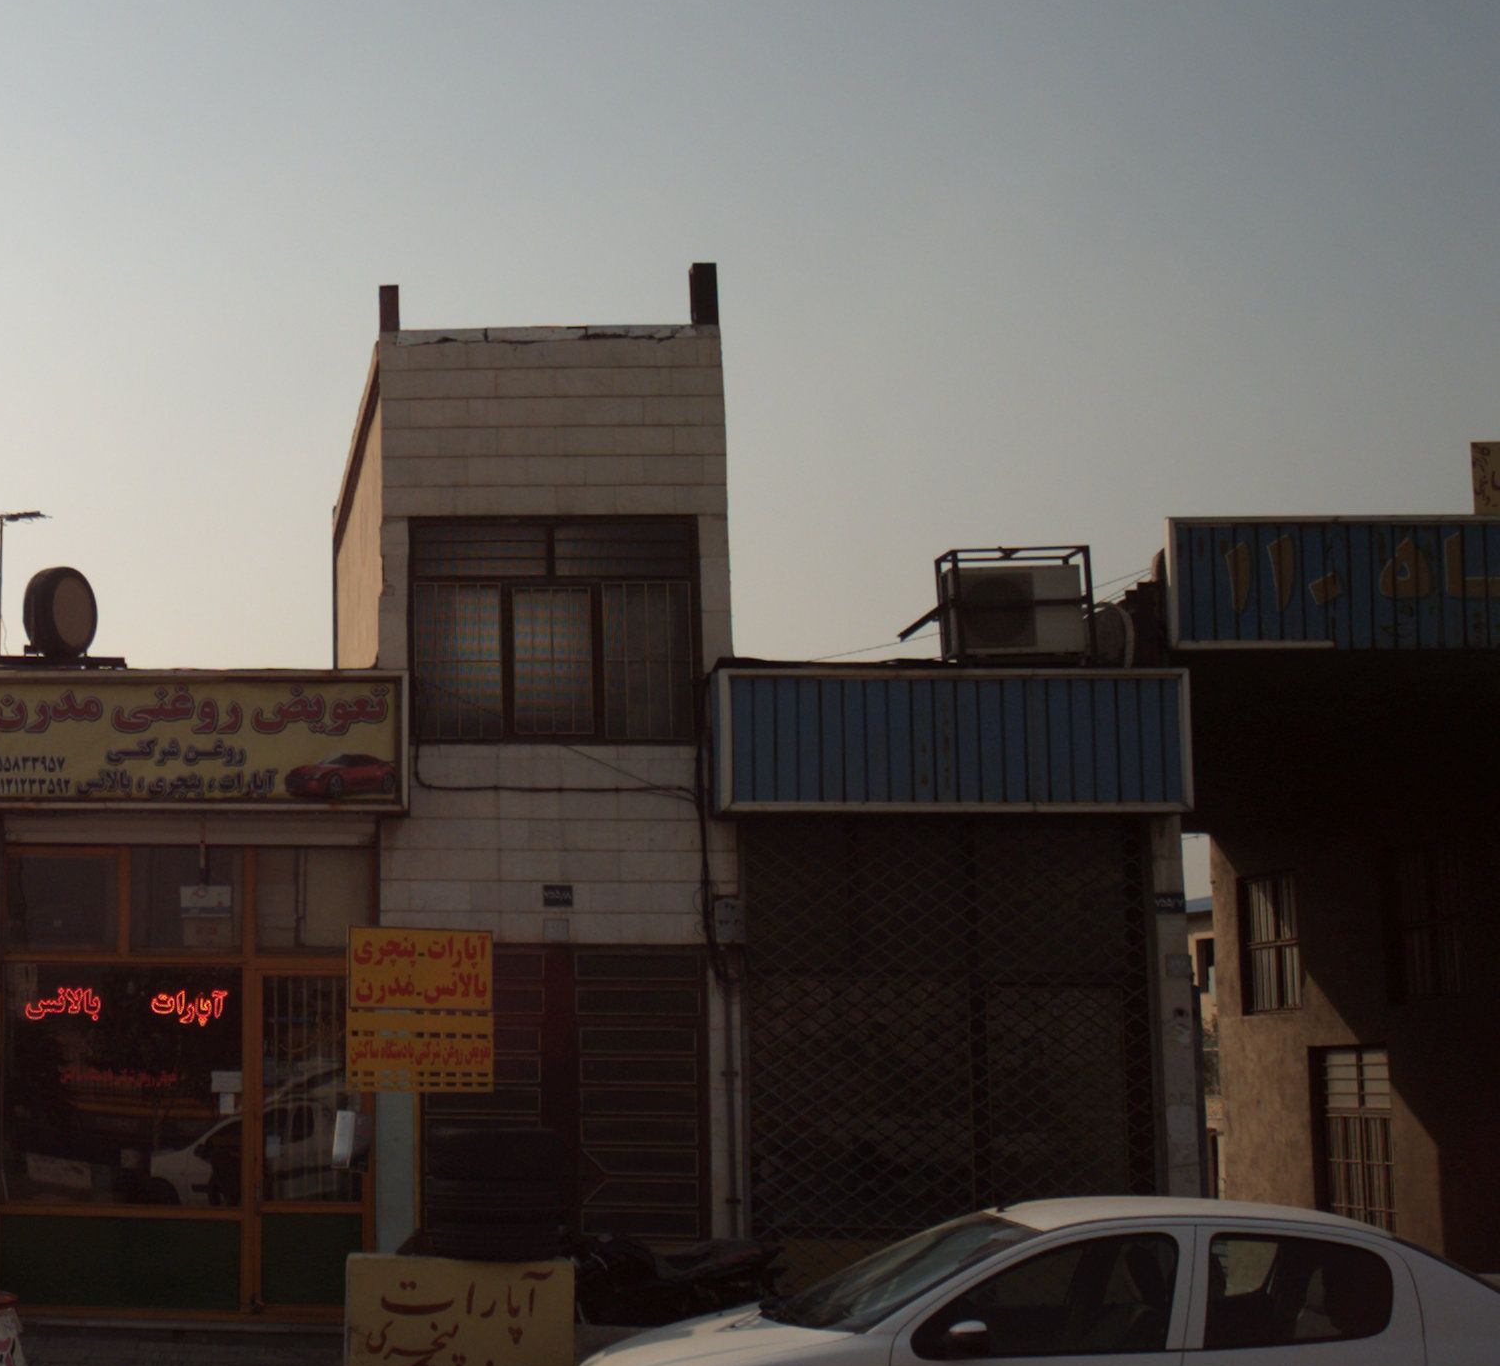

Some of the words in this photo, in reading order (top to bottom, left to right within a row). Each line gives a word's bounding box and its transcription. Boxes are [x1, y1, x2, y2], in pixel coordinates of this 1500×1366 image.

[111, 682, 243, 734] روغنی
[251, 685, 390, 735] تعویض
[105, 738, 181, 766] شرکتی
[184, 738, 246, 766] روغن
[76, 768, 133, 798] بالانس
[25, 987, 100, 1021] بالانس
[151, 990, 228, 1026] آپارات
[381, 1269, 554, 1345] آپارات
